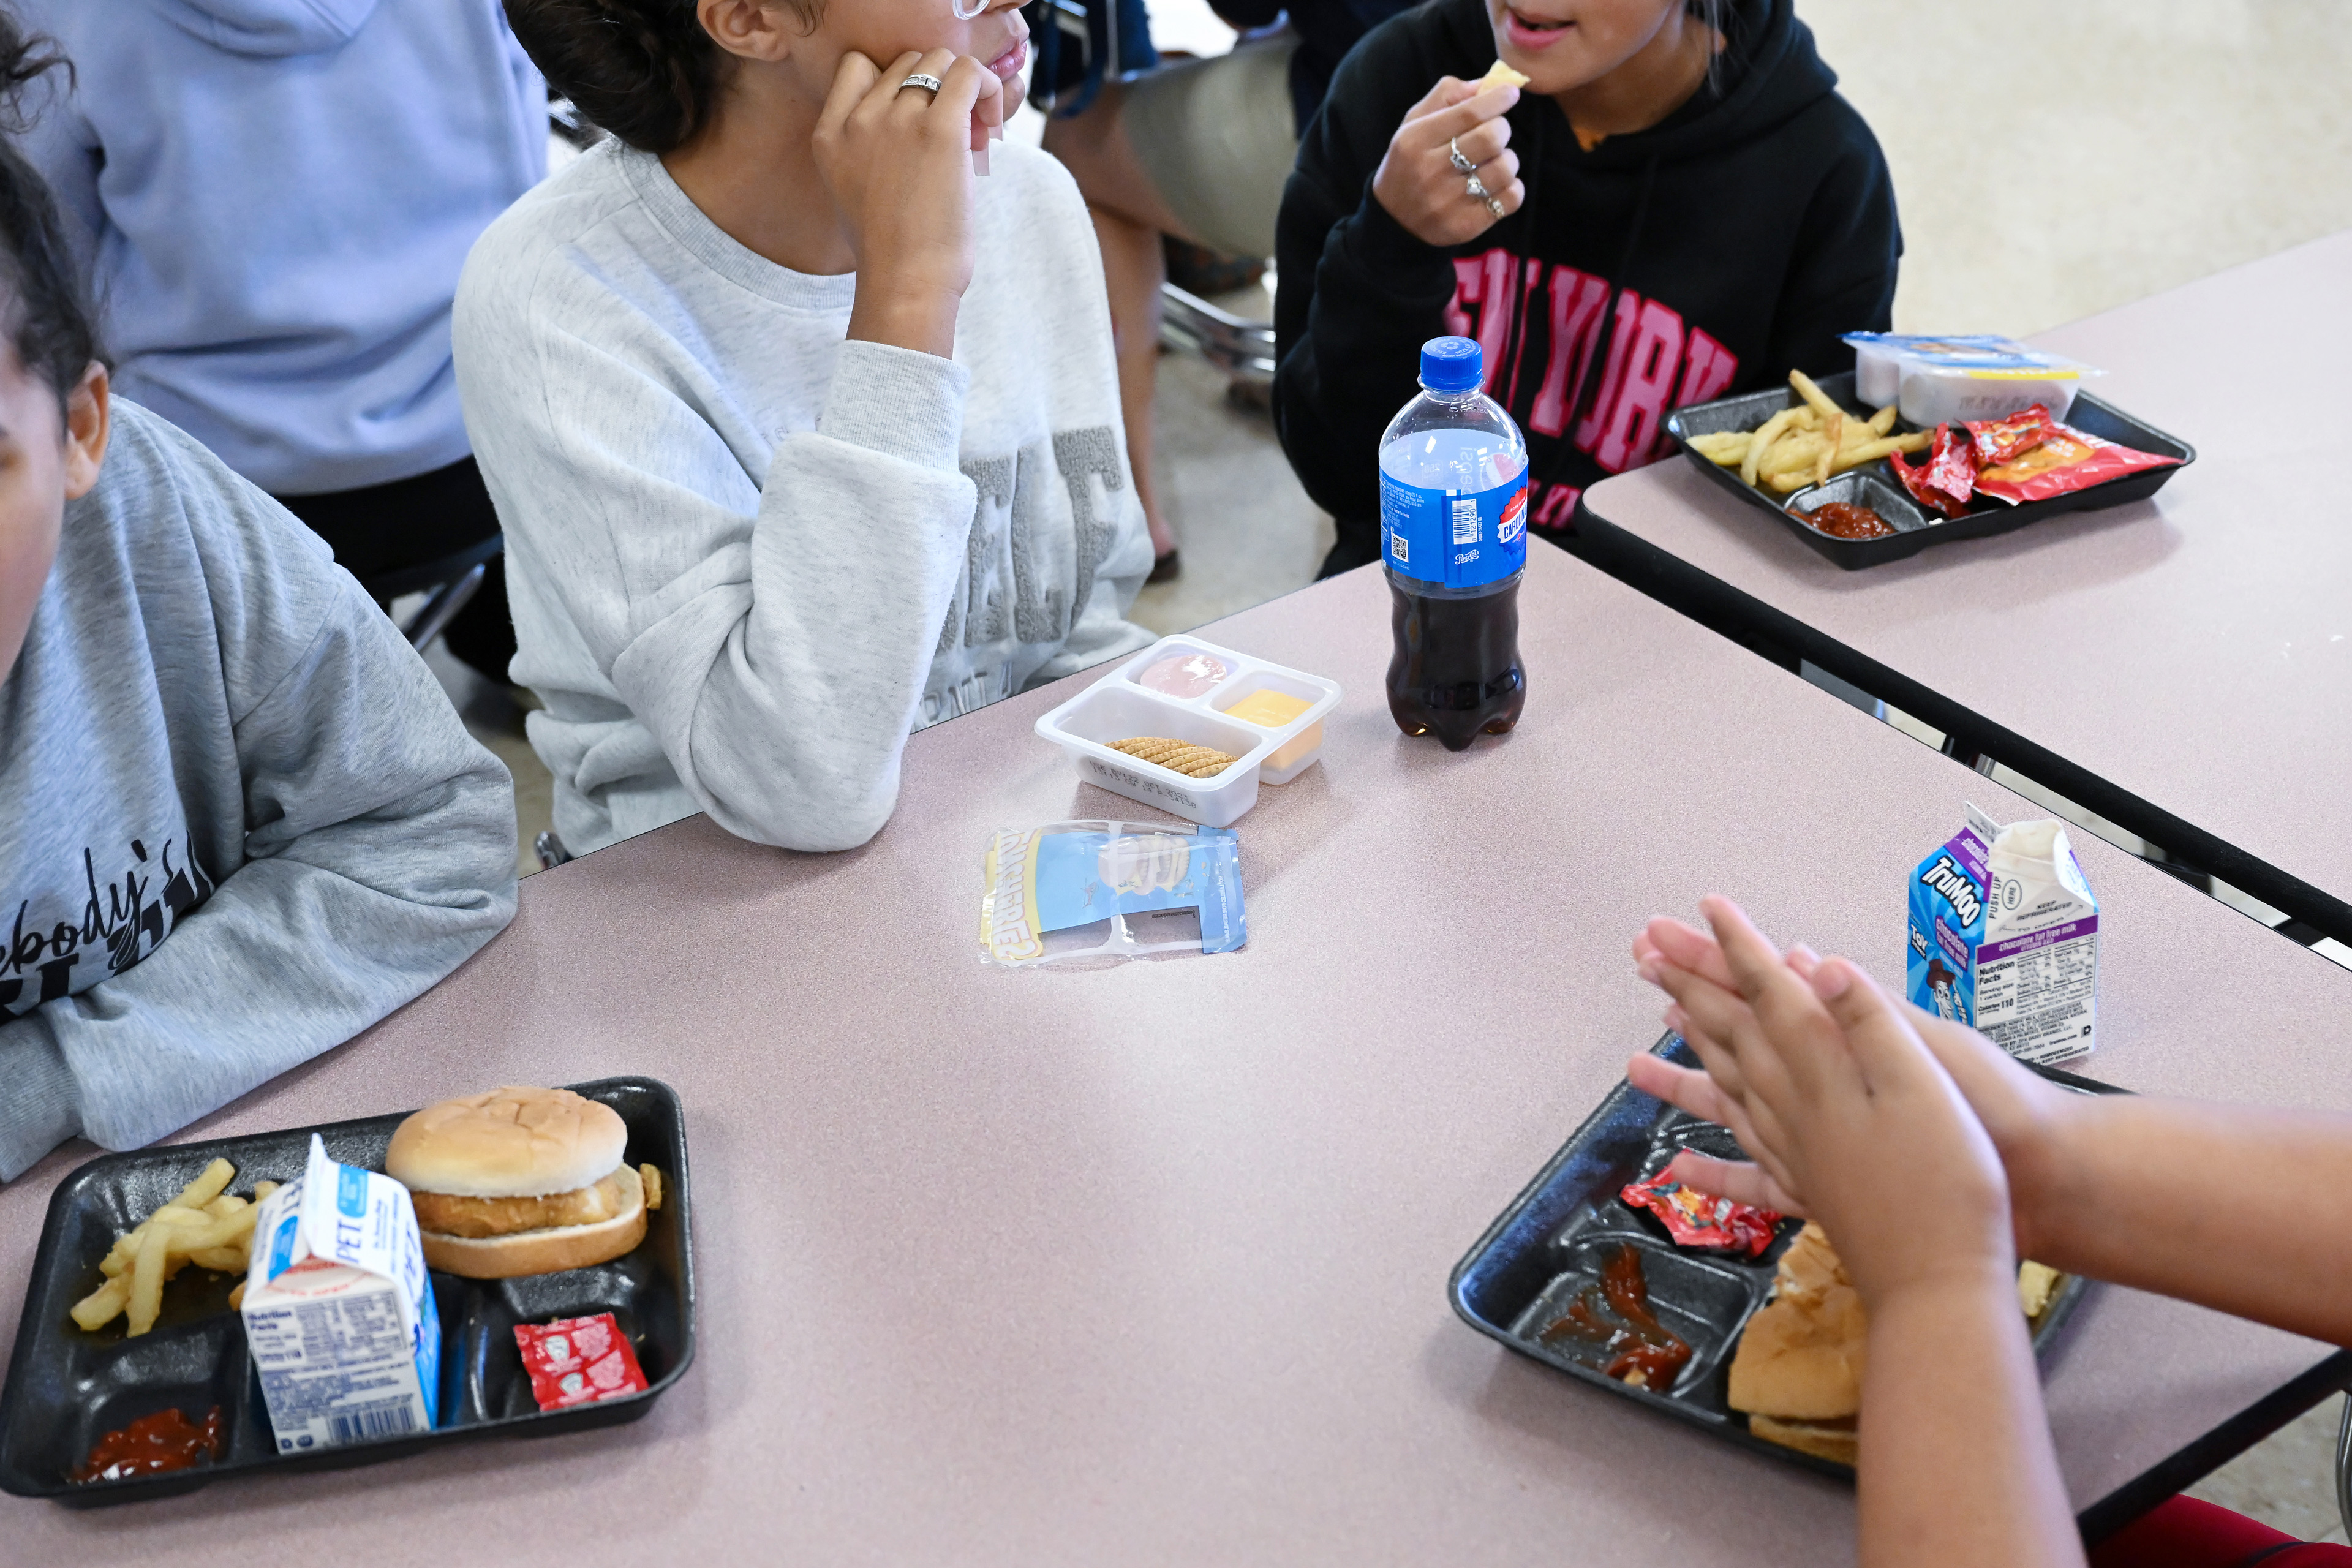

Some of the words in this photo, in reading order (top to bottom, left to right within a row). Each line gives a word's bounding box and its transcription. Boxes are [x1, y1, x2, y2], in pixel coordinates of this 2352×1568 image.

[1144, 780, 1161, 790] OCT
[1921, 856, 1982, 927] TruMoo
[1988, 892, 1999, 919] PUSH
[1994, 876, 2002, 889] UP
[2060, 923, 2077, 935] milk
[1980, 961, 2015, 976] Nutrition
[1980, 974, 2001, 985] Facts
[2001, 998, 2014, 1008] 110
[336, 1219, 363, 1264] PET
